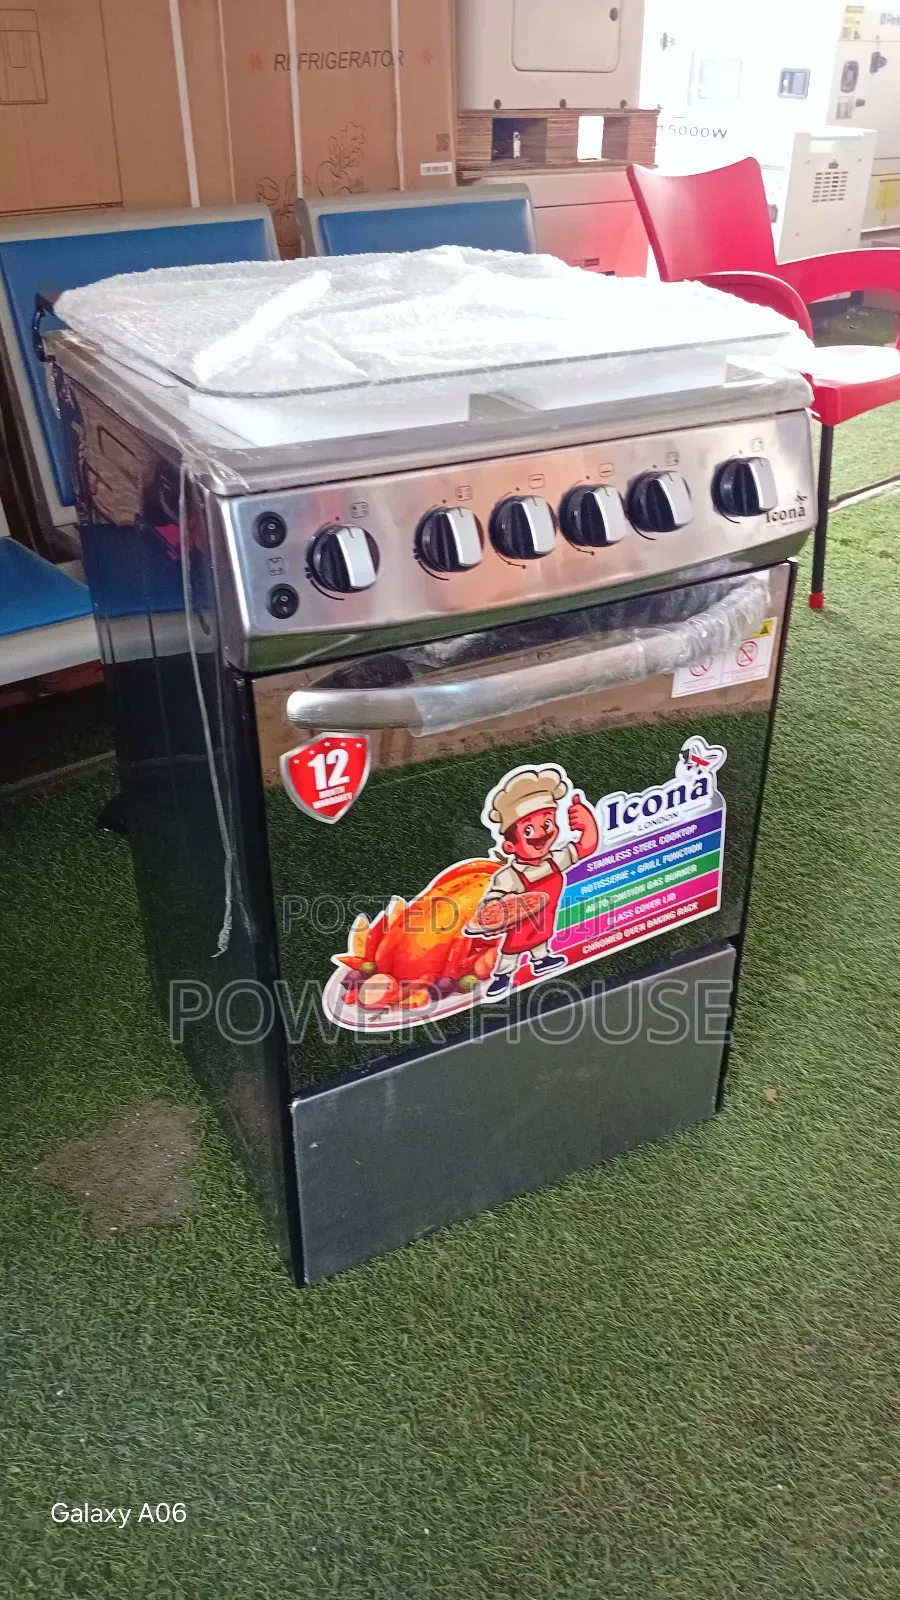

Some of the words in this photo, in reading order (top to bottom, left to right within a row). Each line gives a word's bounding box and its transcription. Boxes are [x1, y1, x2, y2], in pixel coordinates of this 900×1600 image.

[307, 748, 350, 790] 12
[580, 869, 630, 895] ROTISSERIE
[636, 858, 663, 873] GRILL
[662, 842, 703, 864] FUNCTION
[586, 848, 632, 872] STAINLESS
[632, 839, 658, 855] STEEL
[658, 824, 698, 845] COOKTOP
[646, 876, 664, 890] GAS
[664, 864, 698, 883] BURNER
[634, 898, 662, 914] COVER
[662, 892, 677, 904] LID
[582, 931, 624, 954] CHROMED
[623, 922, 646, 938] OVEN
[646, 910, 677, 929] BAKING
[676, 901, 699, 917] RACK
